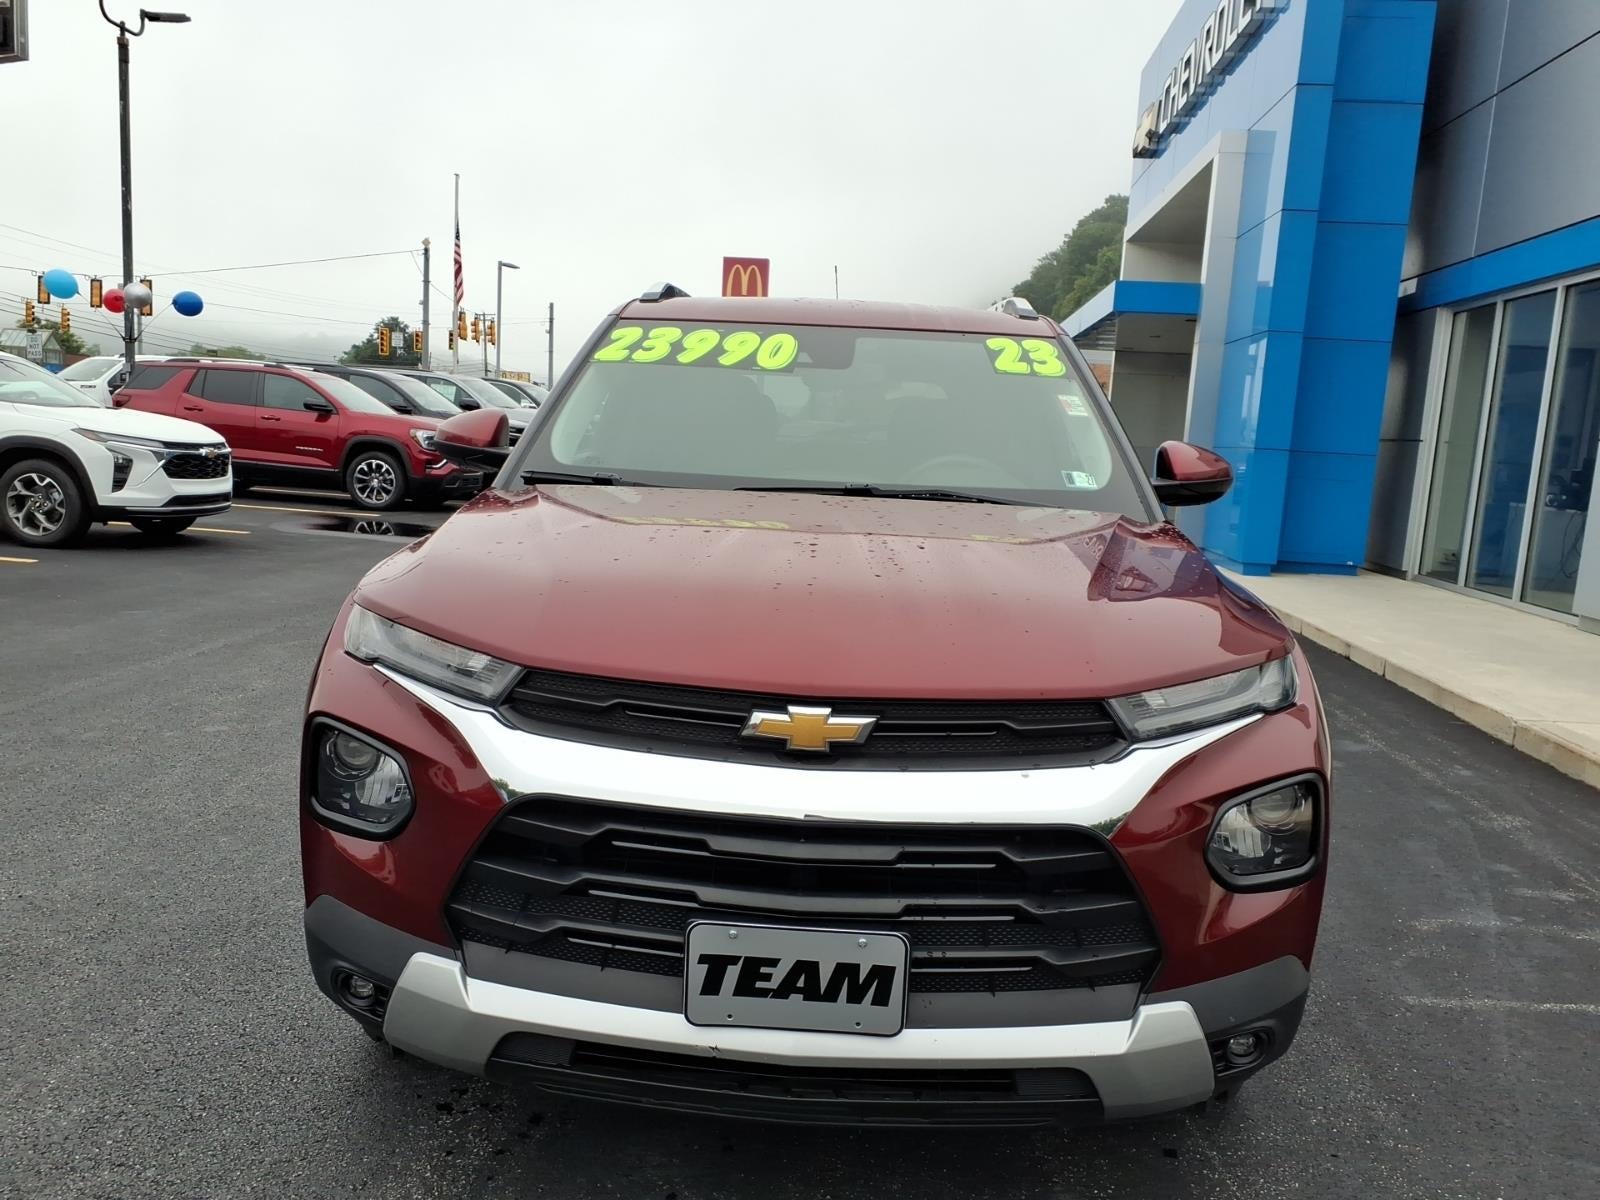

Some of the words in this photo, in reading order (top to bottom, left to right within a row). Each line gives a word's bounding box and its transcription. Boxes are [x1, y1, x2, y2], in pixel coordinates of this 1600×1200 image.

[1158, 0, 1264, 135] CHEVROL
[594, 326, 799, 370] 23990
[985, 337, 1067, 377] 23
[696, 953, 897, 1008] TEAM
